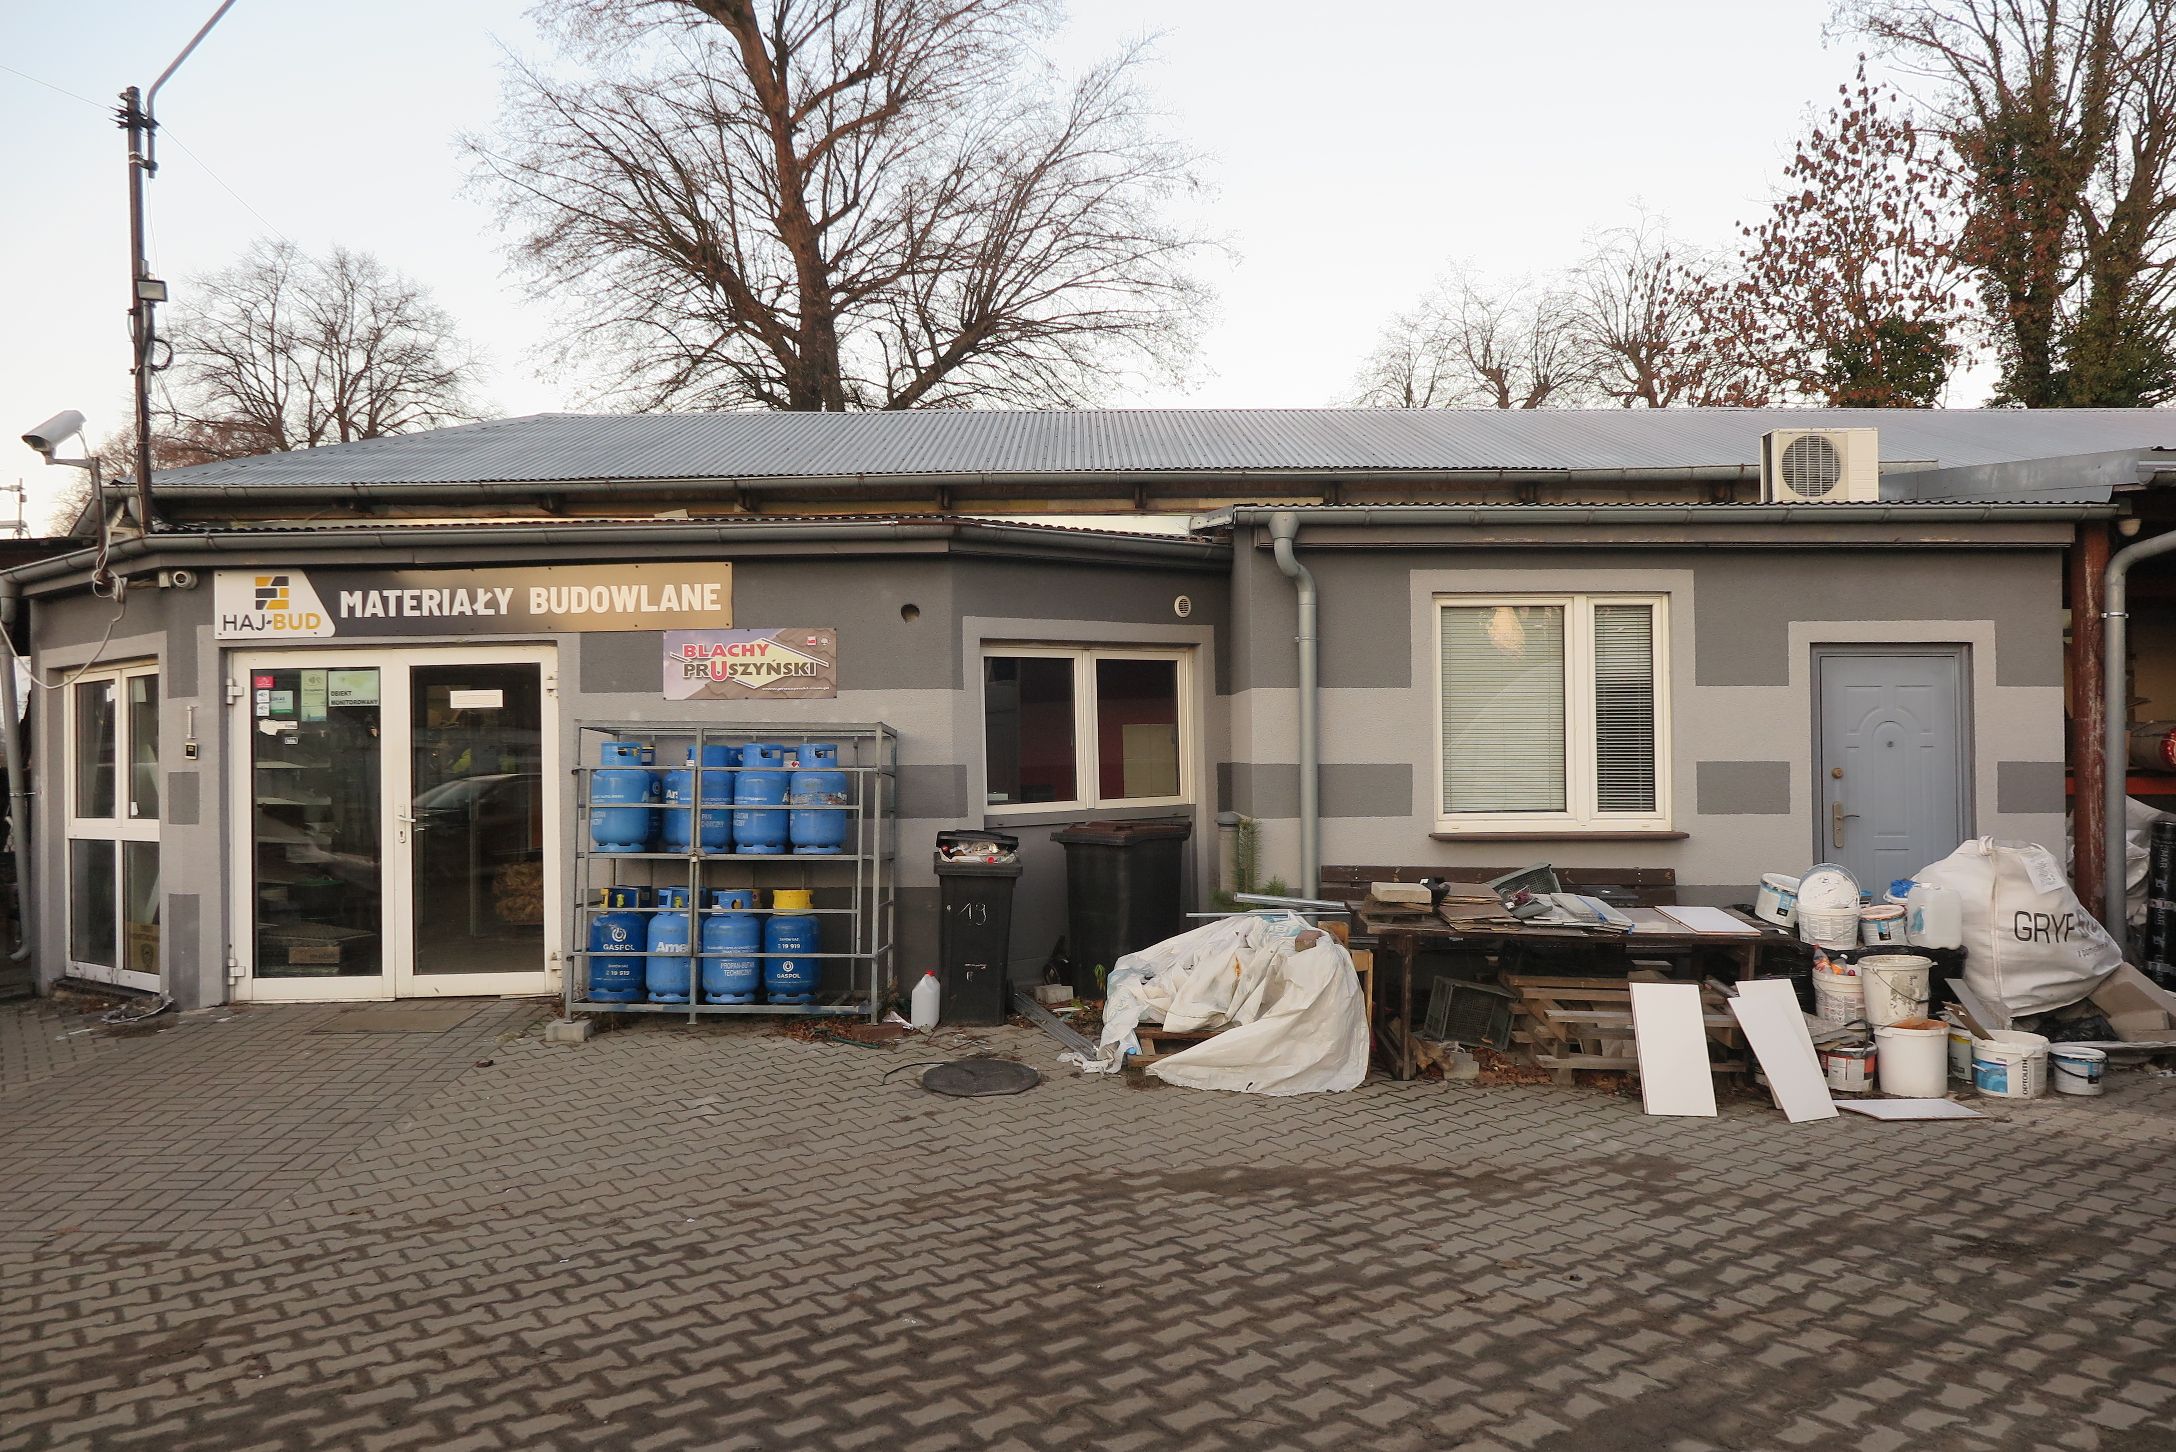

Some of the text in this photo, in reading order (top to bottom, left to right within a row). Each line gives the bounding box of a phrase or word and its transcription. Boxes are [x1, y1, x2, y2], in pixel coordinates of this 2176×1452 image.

[340, 583, 722, 618] MATERIAŁY BUDOWLANE
[222, 612, 322, 632] HAJ-BUD
[683, 643, 770, 658] BLACHY
[683, 659, 816, 681] PRUSZYŃSKI
[603, 943, 636, 951] GASPOL
